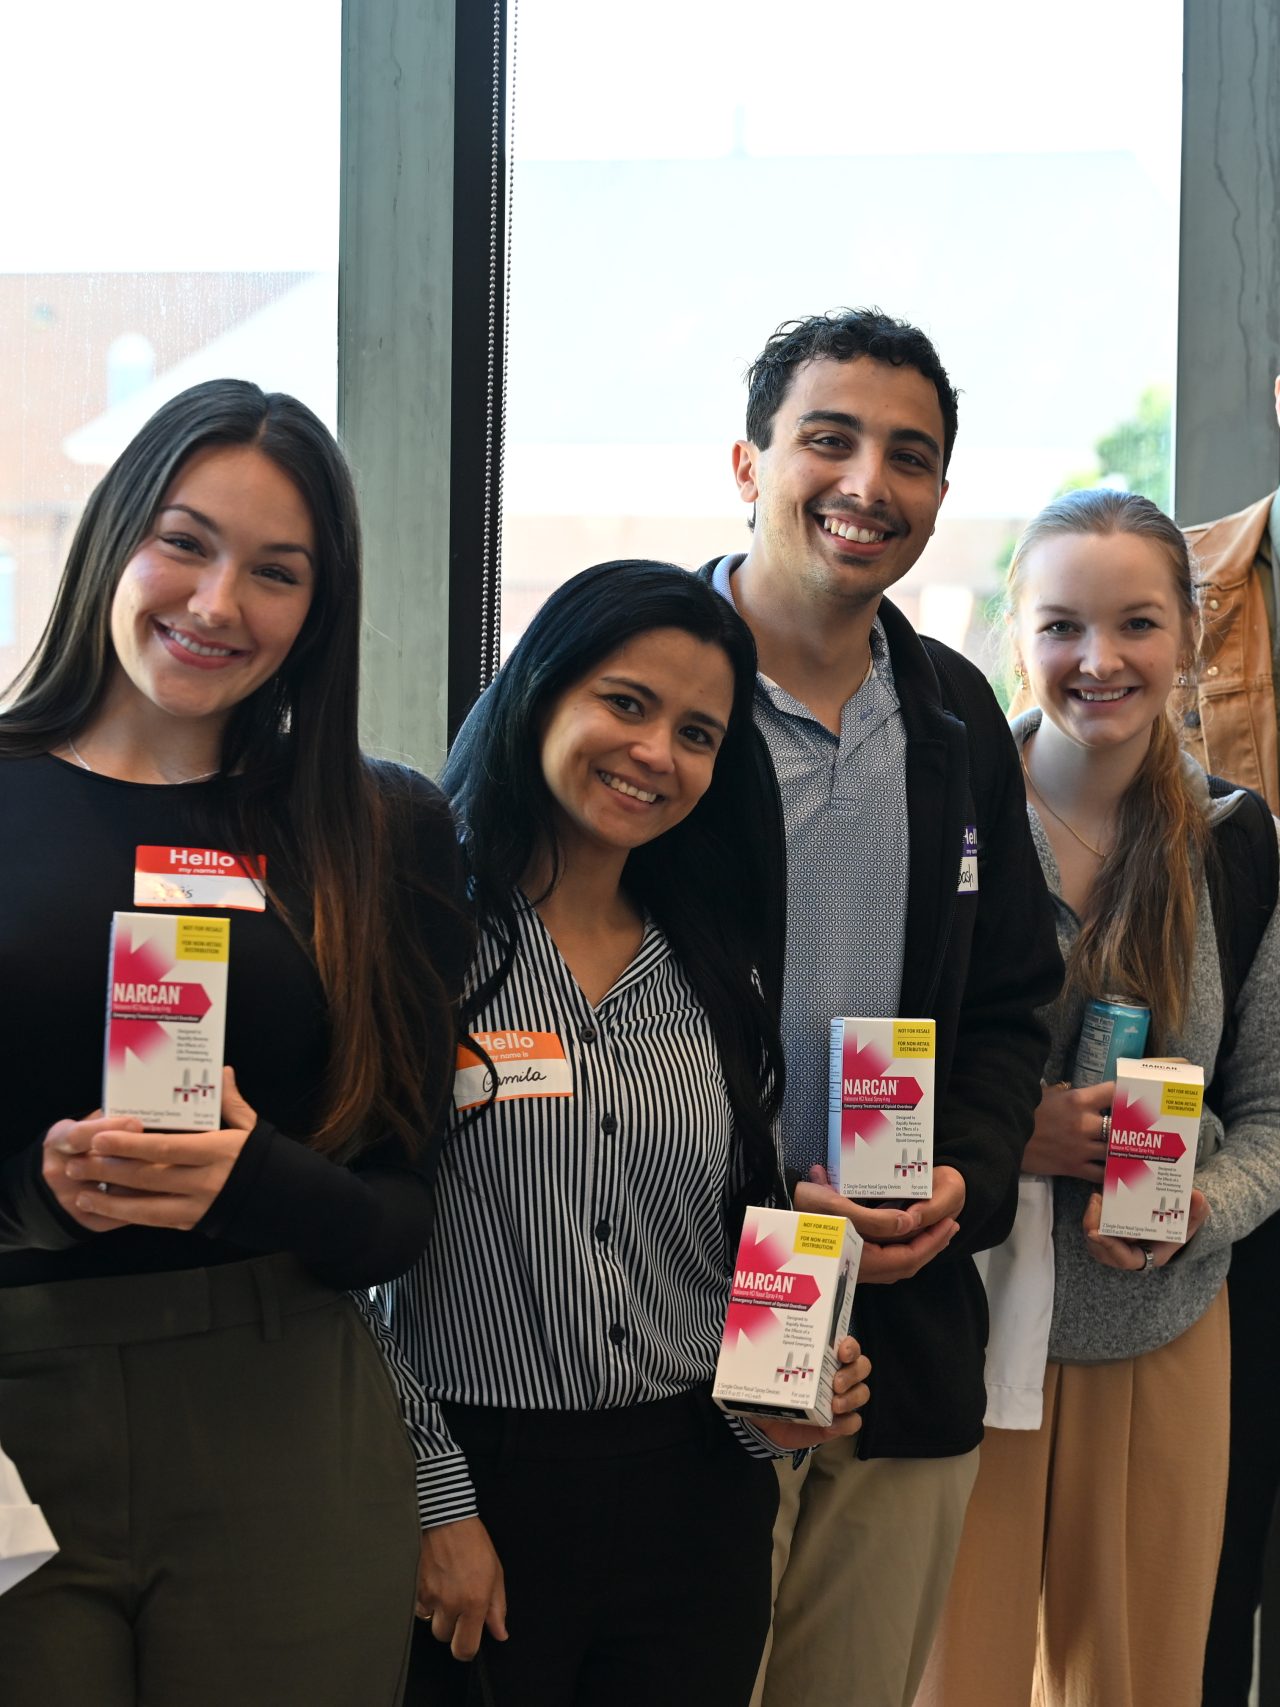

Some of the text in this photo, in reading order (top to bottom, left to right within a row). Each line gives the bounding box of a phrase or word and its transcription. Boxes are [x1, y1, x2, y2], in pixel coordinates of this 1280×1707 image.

[170, 849, 235, 867] Hello
[113, 982, 180, 1005] NARCAN
[475, 1033, 534, 1050] Hello
[844, 1079, 896, 1096] NARCAN
[1111, 1129, 1162, 1149] NARCAN
[802, 1242, 833, 1250] DISTRIBUTION
[734, 1270, 794, 1293] NARCAN
